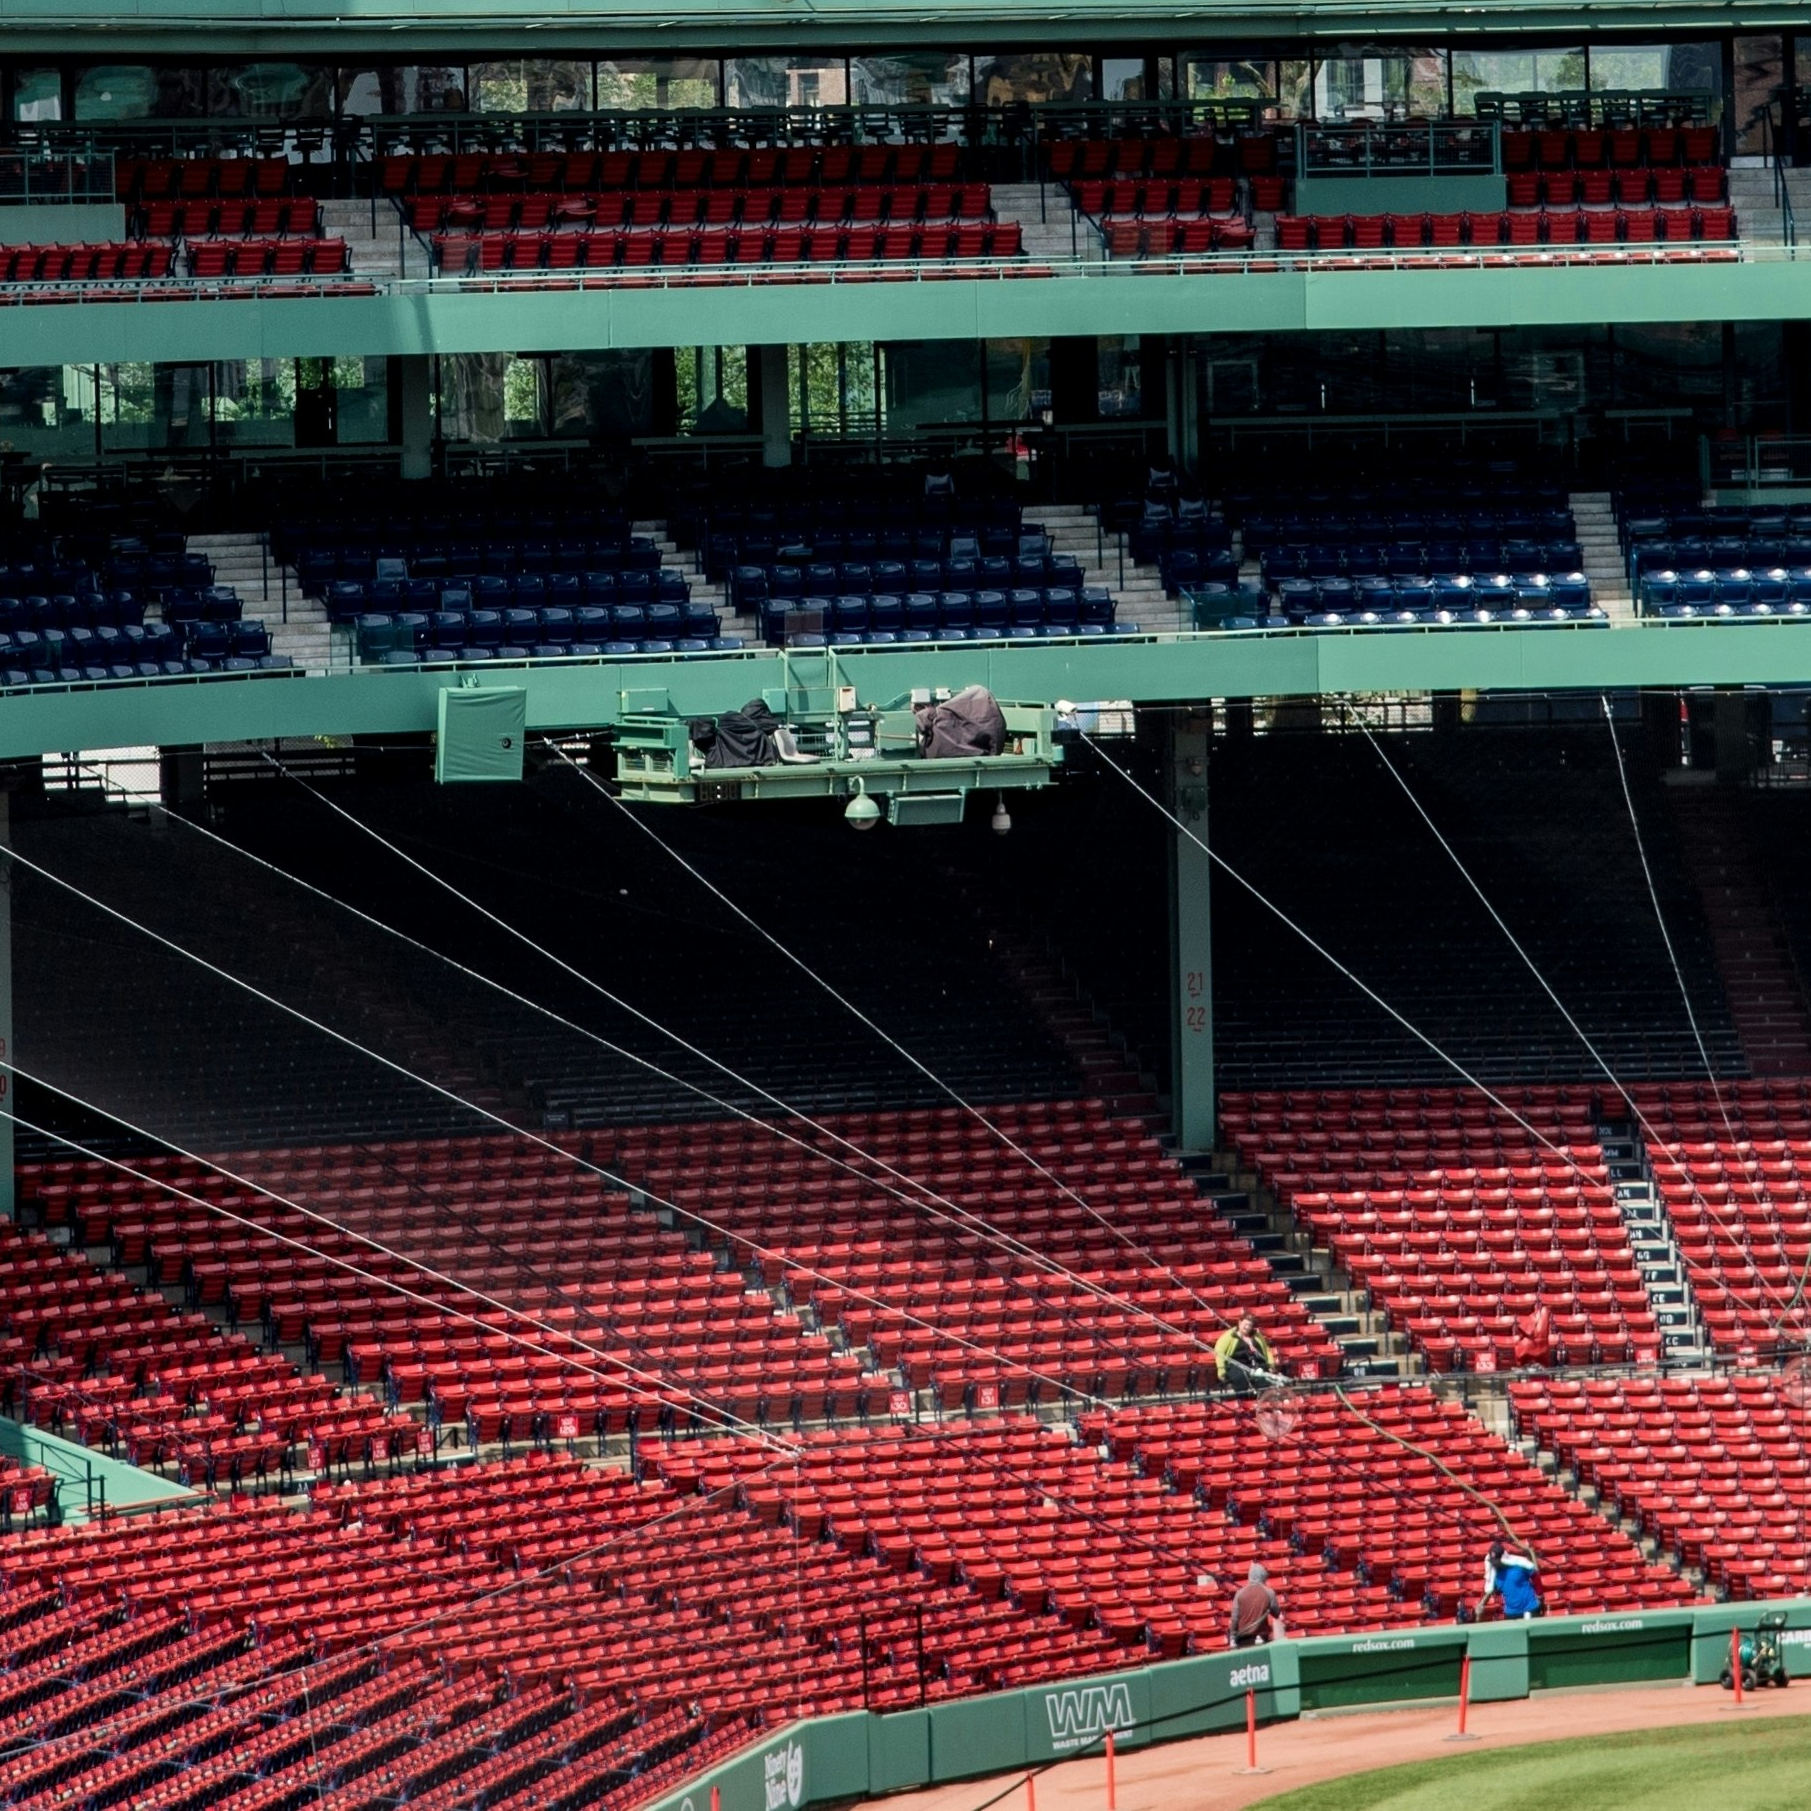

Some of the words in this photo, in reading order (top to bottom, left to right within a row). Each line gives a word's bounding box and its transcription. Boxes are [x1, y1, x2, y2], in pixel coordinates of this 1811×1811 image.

[1188, 971, 1204, 991] 21
[1187, 1007, 1206, 1025] 22
[1610, 1168, 1622, 1177] LL
[1581, 1619, 1643, 1634] redsox.com
[1352, 1638, 1415, 1652] redsox.com
[1229, 1664, 1270, 1687] aetna
[1045, 1682, 1134, 1737] WM
[1053, 1738, 1079, 1750] WASTE
